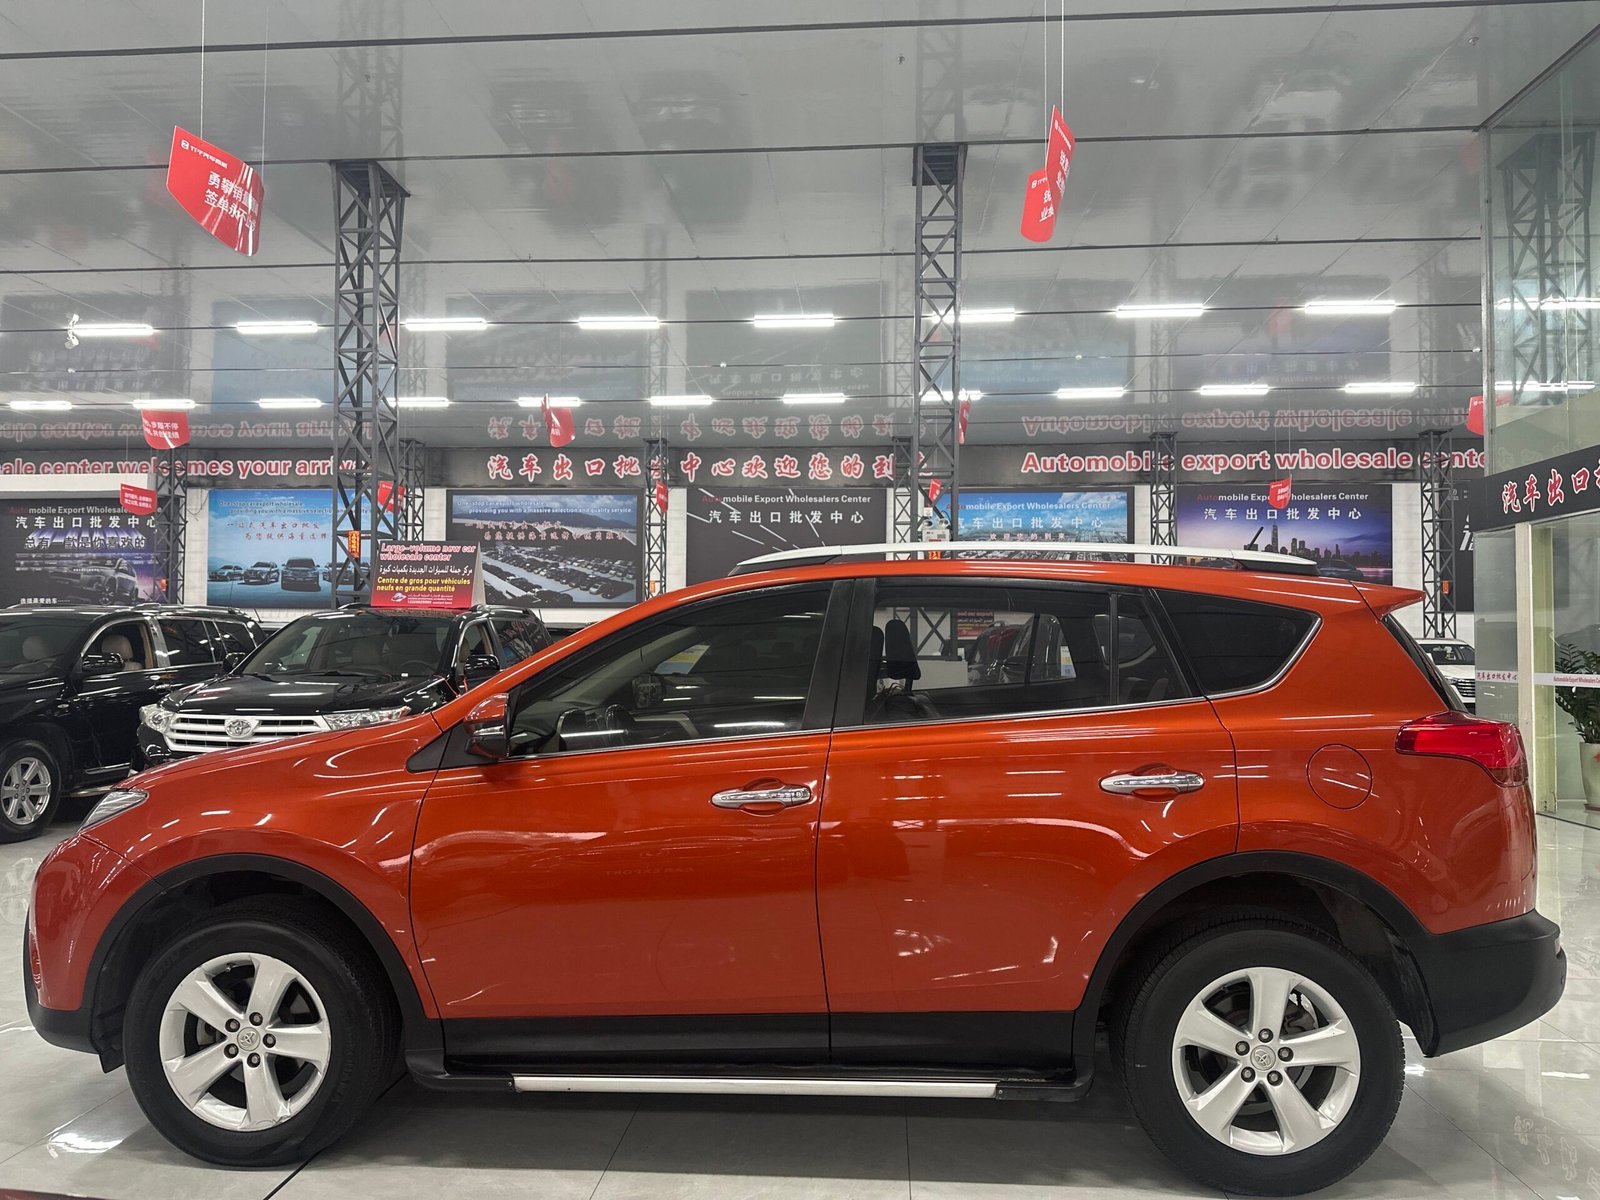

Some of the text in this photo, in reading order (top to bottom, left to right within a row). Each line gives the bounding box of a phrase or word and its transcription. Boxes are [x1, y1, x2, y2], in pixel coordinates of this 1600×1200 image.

[1181, 451, 1271, 475] export
[1275, 448, 1414, 472] wholesale
[39, 459, 114, 475] center
[238, 459, 293, 479] your
[754, 494, 783, 504] Export
[785, 493, 840, 503] Wholesalers
[841, 494, 872, 503] Center
[1290, 493, 1337, 501] holesalers
[1338, 492, 1369, 501] Center
[57, 506, 85, 515] Export
[996, 502, 1025, 511] Export
[1026, 502, 1080, 510] Wholesalers
[1081, 501, 1111, 509] Center
[709, 510, 864, 524] 汽车出口批发中心
[1204, 508, 1362, 521] 汽车出口批发中心
[24, 536, 147, 549] 总有一款是你喜欢的
[442, 545, 461, 553] new
[380, 552, 452, 561] wholesale center
[377, 576, 399, 584] Centre
[441, 577, 471, 585] véhicules
[404, 584, 427, 593] grande
[428, 584, 455, 593] quantité
